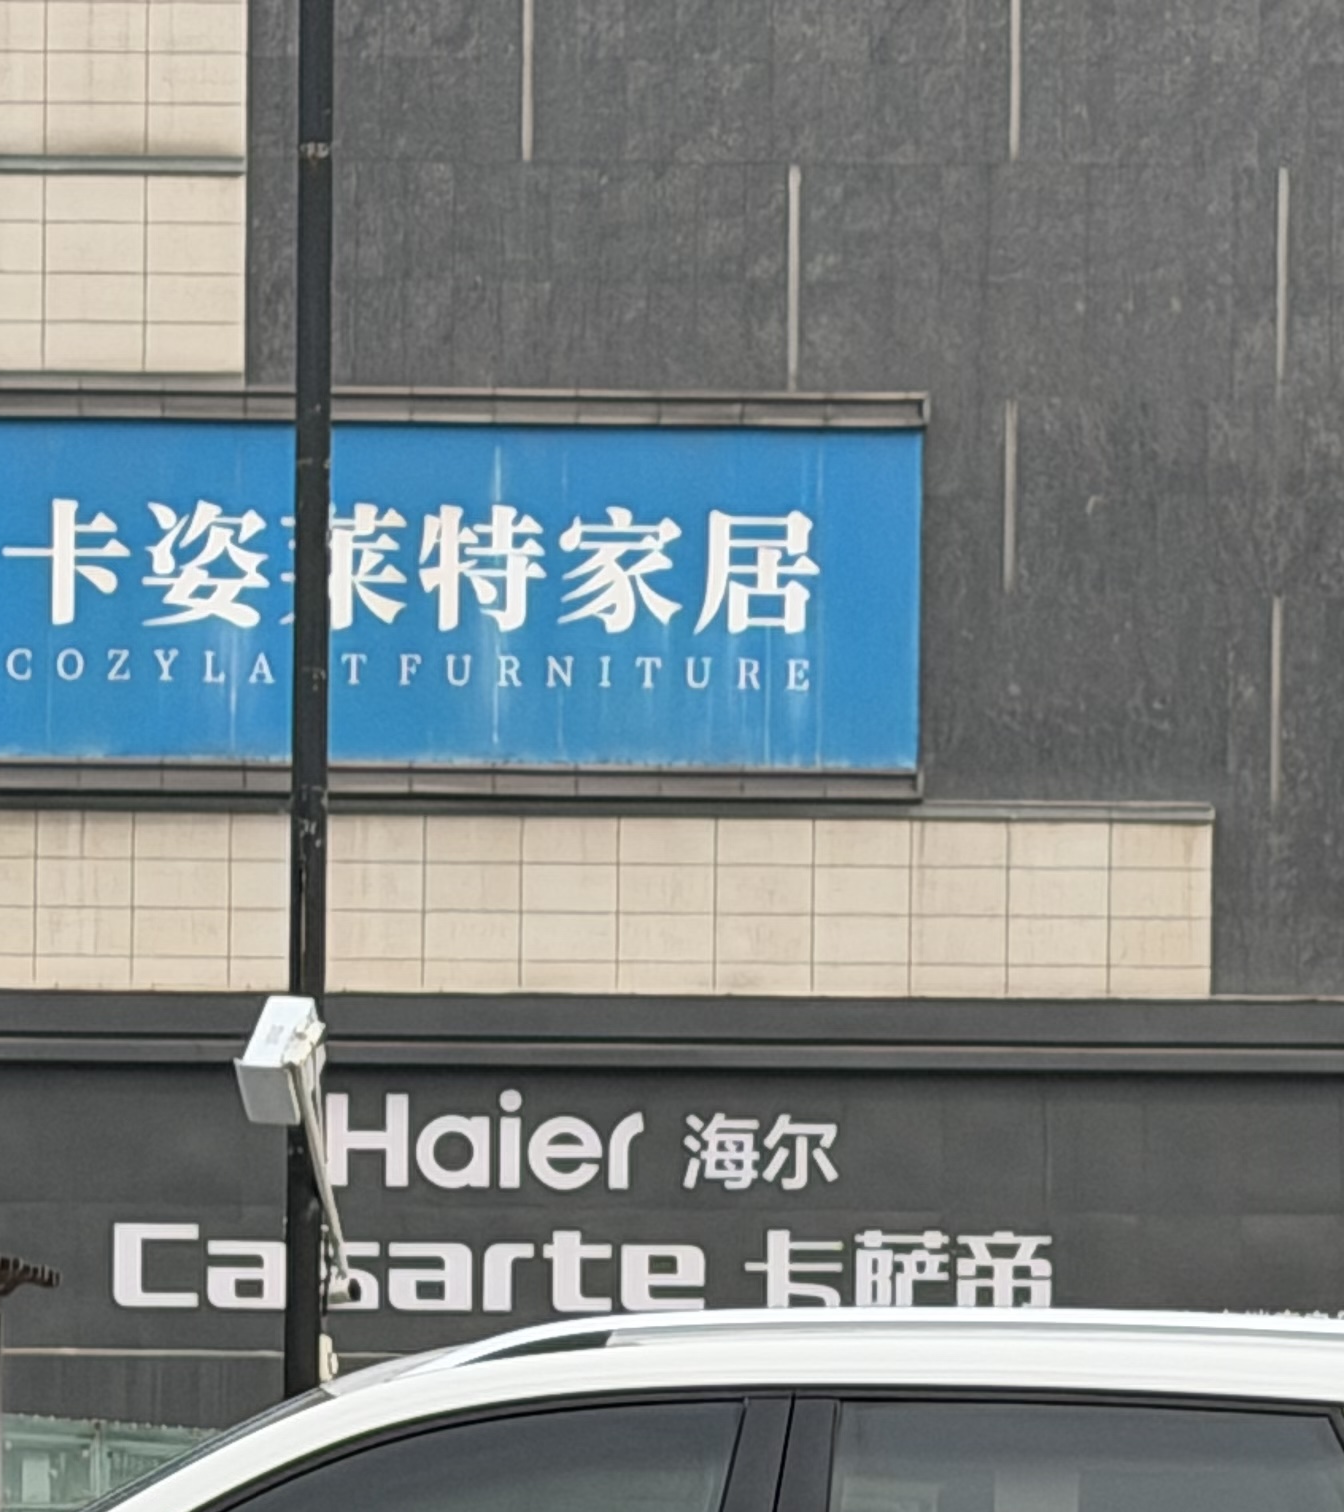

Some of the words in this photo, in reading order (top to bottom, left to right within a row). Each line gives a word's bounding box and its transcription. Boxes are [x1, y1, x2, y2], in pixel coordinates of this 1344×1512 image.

[1, 497, 821, 635] 卡姿莱特家居
[5, 646, 811, 692] COZYLATFURNITURE
[325, 1088, 644, 1190] Haier
[683, 1112, 840, 1191] 海尔
[744, 1228, 1053, 1308] 卡萨帝
